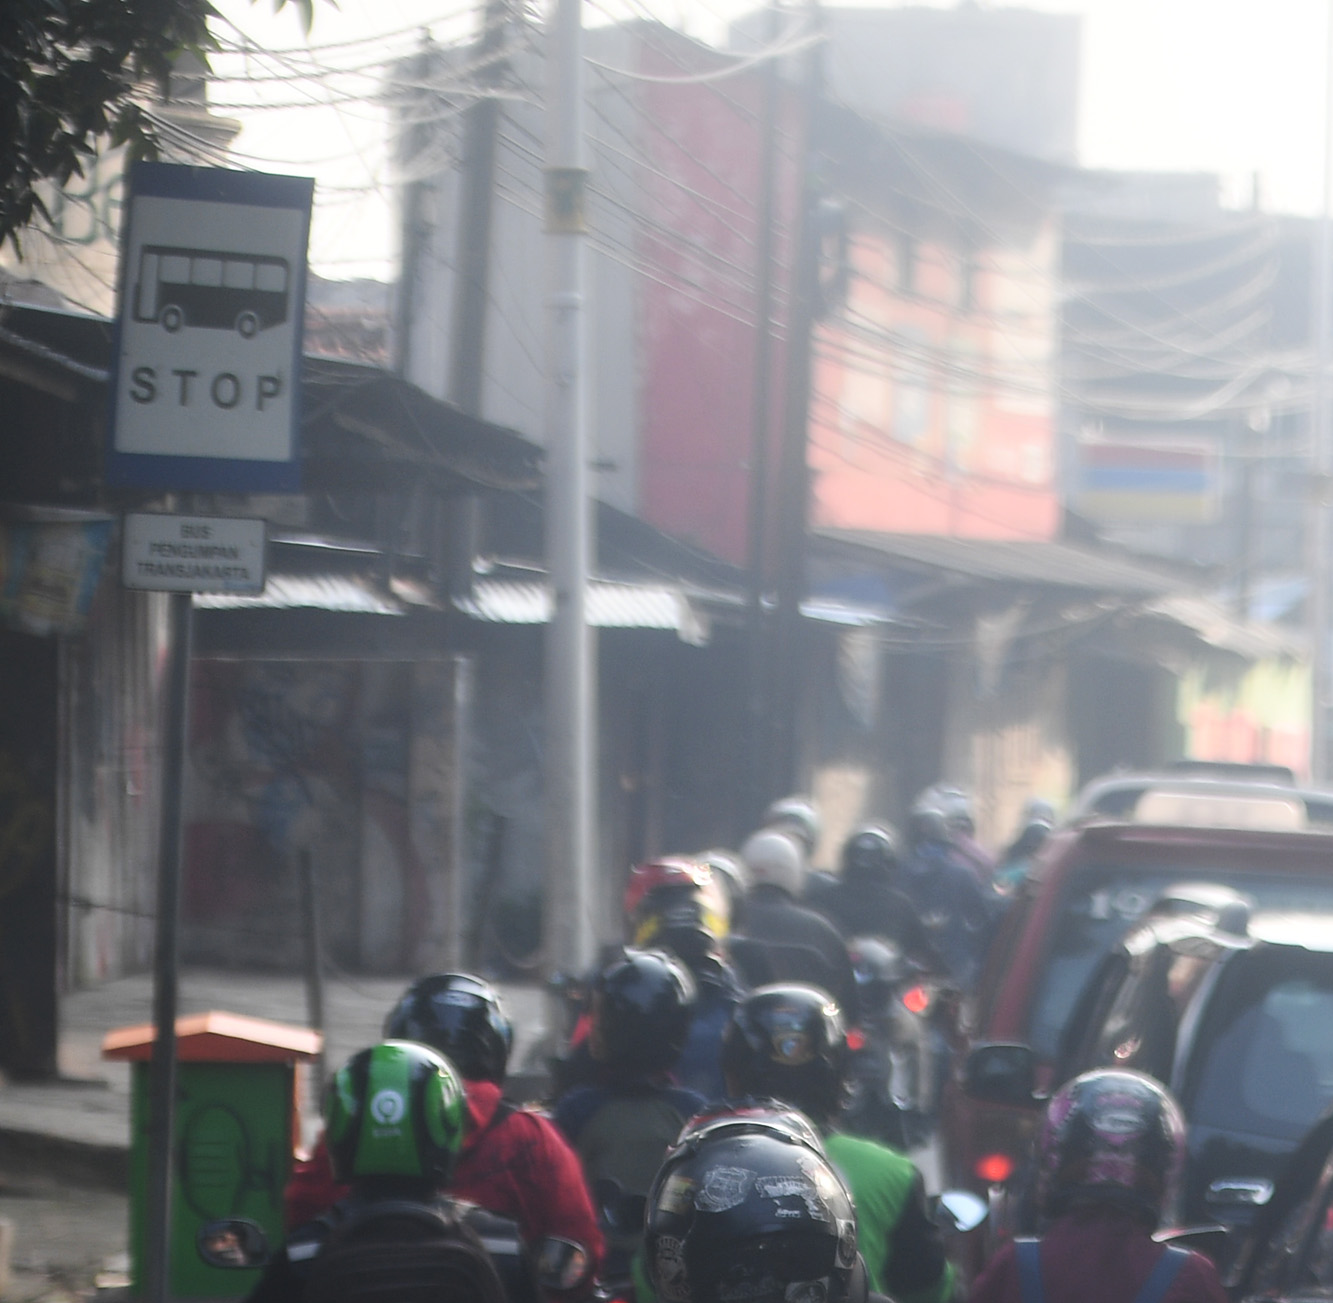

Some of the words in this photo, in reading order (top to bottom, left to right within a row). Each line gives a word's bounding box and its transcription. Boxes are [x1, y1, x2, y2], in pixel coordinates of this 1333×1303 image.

[128, 366, 281, 411] STOP
[180, 523, 212, 539] BUS
[150, 542, 240, 560] PENGUMPAN
[137, 561, 250, 580] TRANSJAKARTA
